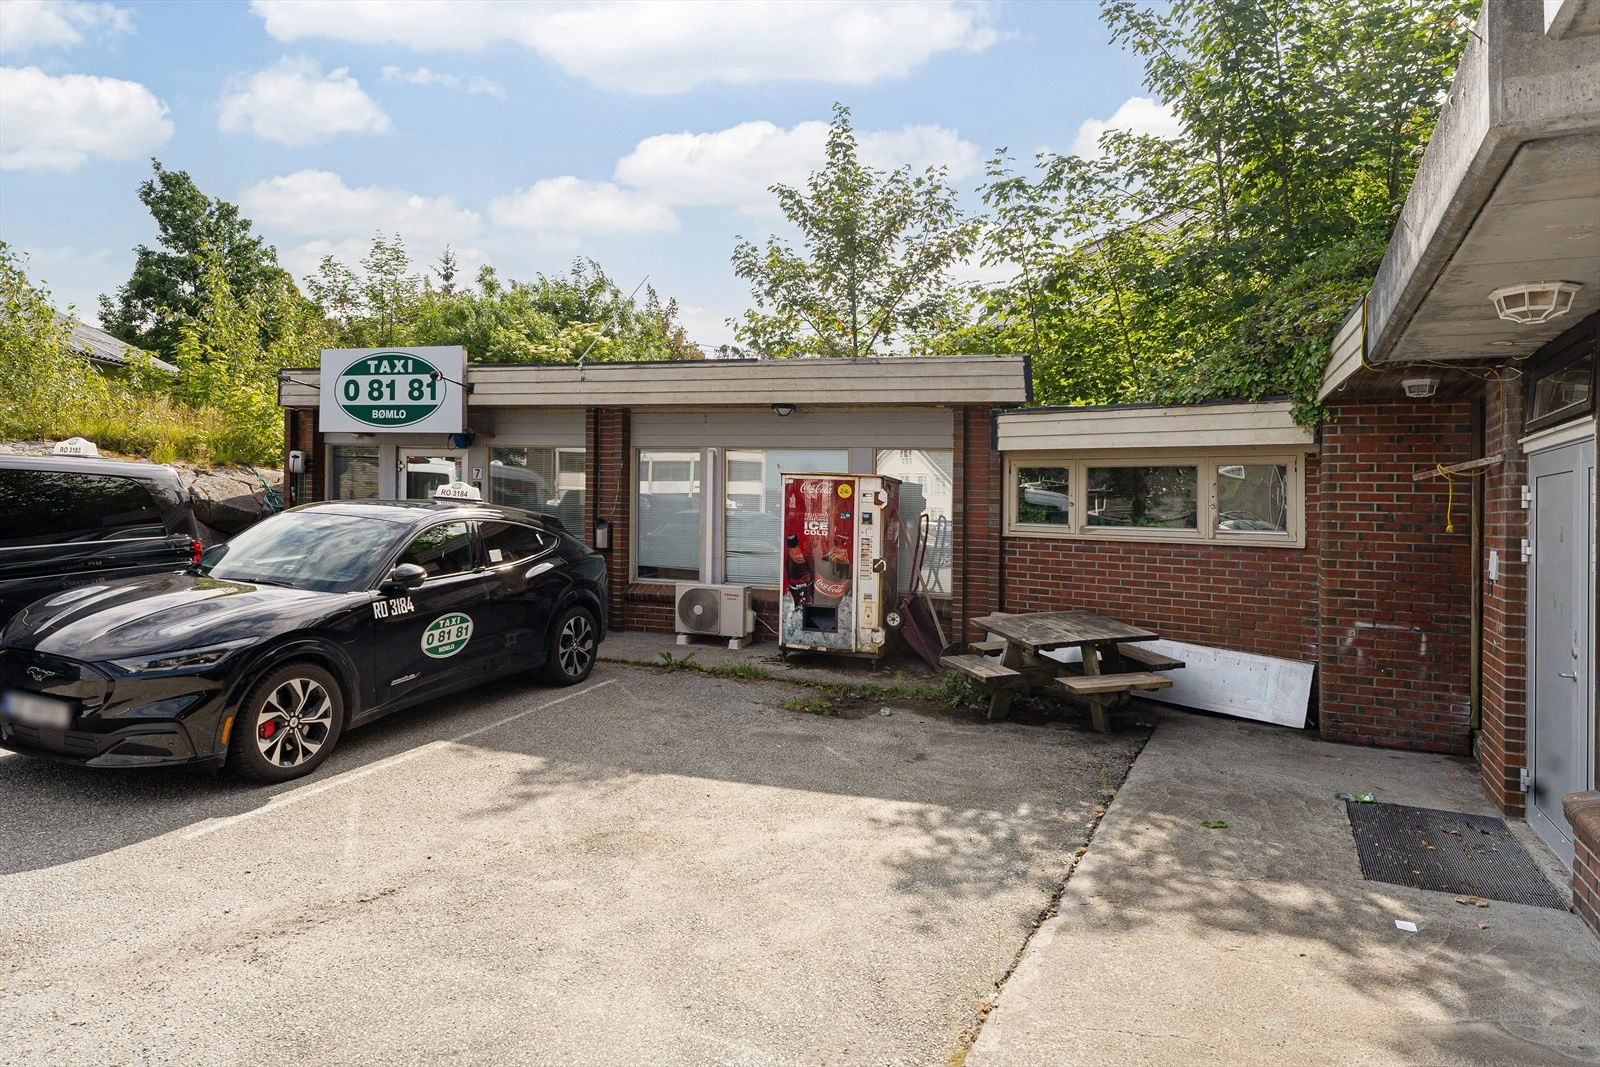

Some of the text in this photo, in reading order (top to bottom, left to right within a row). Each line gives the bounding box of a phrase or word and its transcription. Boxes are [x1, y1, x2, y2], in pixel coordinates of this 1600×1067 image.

[367, 359, 413, 373] TAXI
[344, 378, 437, 401] 0 81 81
[371, 409, 407, 419] BØMLO
[474, 469, 480, 478] 7
[453, 490, 468, 498] 3184
[800, 481, 834, 494] Coca-Cola
[804, 521, 829, 531] ICE
[816, 579, 844, 594] Coca-Cola
[373, 597, 415, 619] RO 3184
[439, 617, 460, 628] TAXI
[426, 625, 469, 646] 0 81 81
